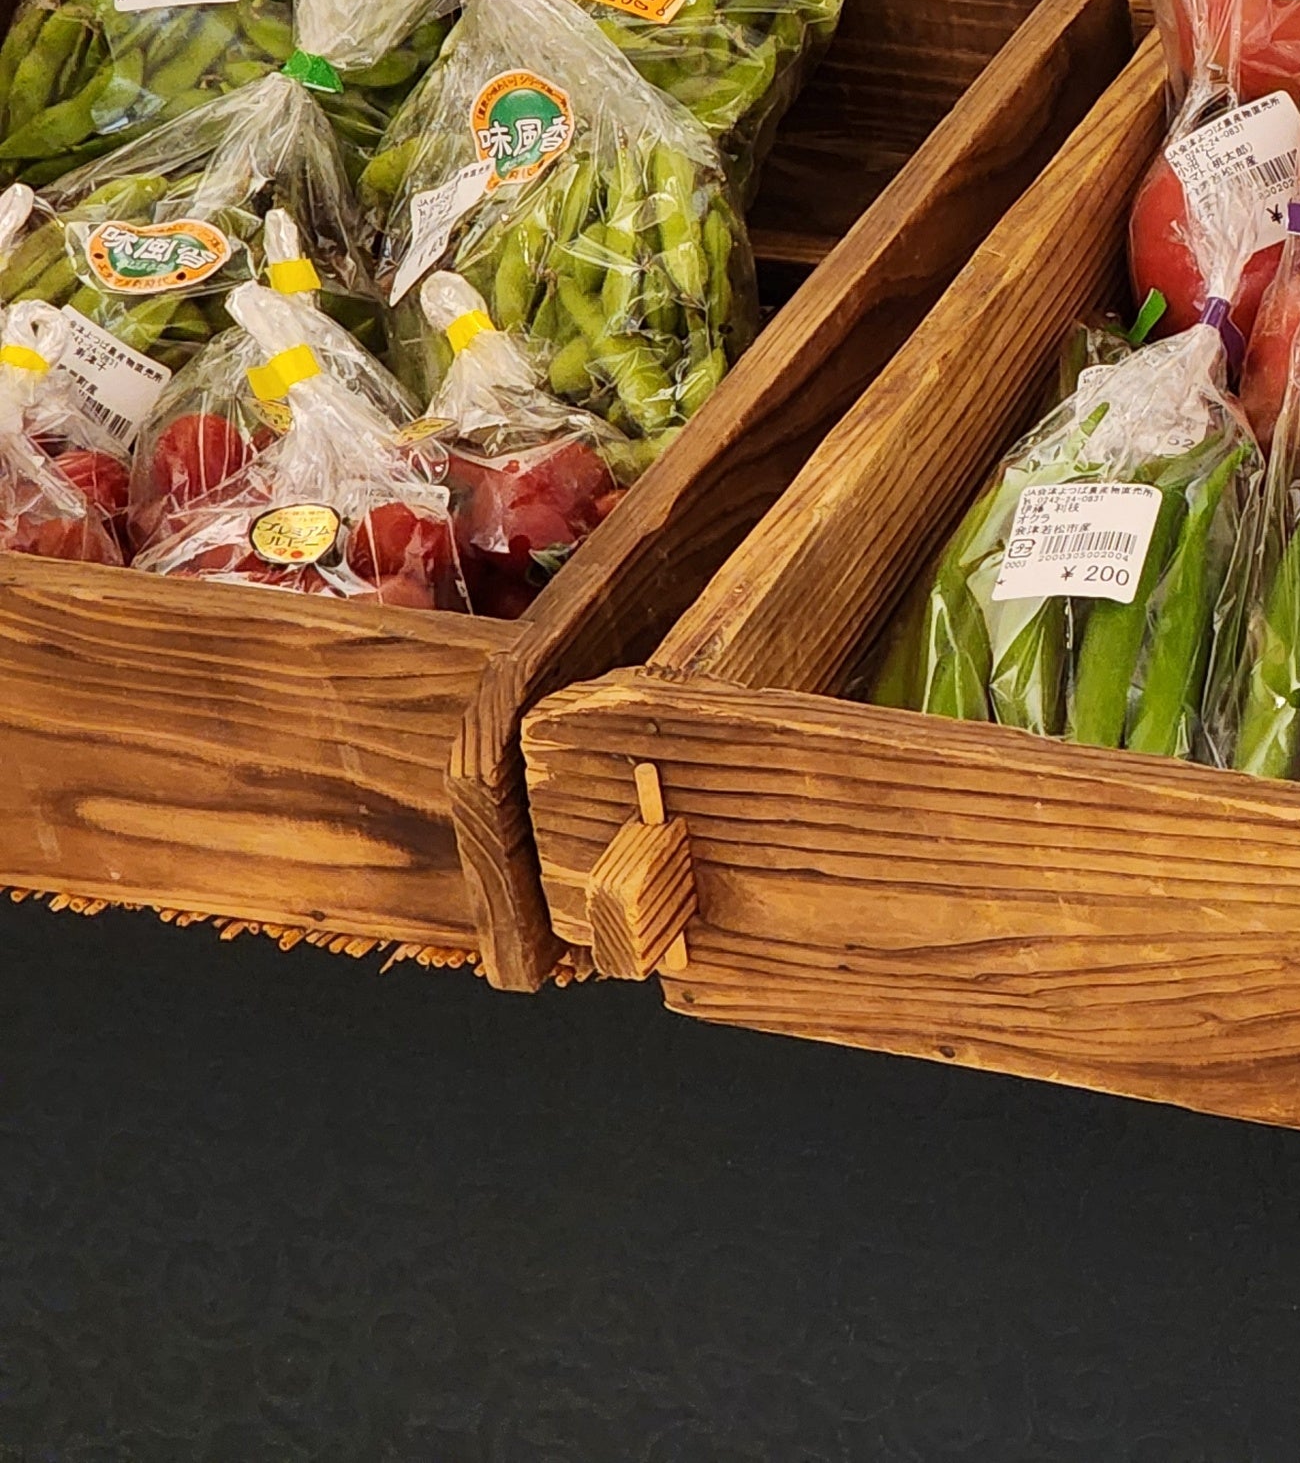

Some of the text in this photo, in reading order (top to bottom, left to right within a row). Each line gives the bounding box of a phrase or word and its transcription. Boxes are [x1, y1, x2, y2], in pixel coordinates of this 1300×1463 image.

[1184, 123, 1245, 161] 0242-24-0831
[1266, 203, 1284, 225] ¥
[1024, 486, 1154, 498] JA会津よつば農産物直売所
[1017, 513, 1051, 525] オクラ
[1015, 522, 1092, 536] 会津若松市産
[1038, 552, 1130, 563] 2000305002004
[1060, 565, 1130, 586] ¥ 200
